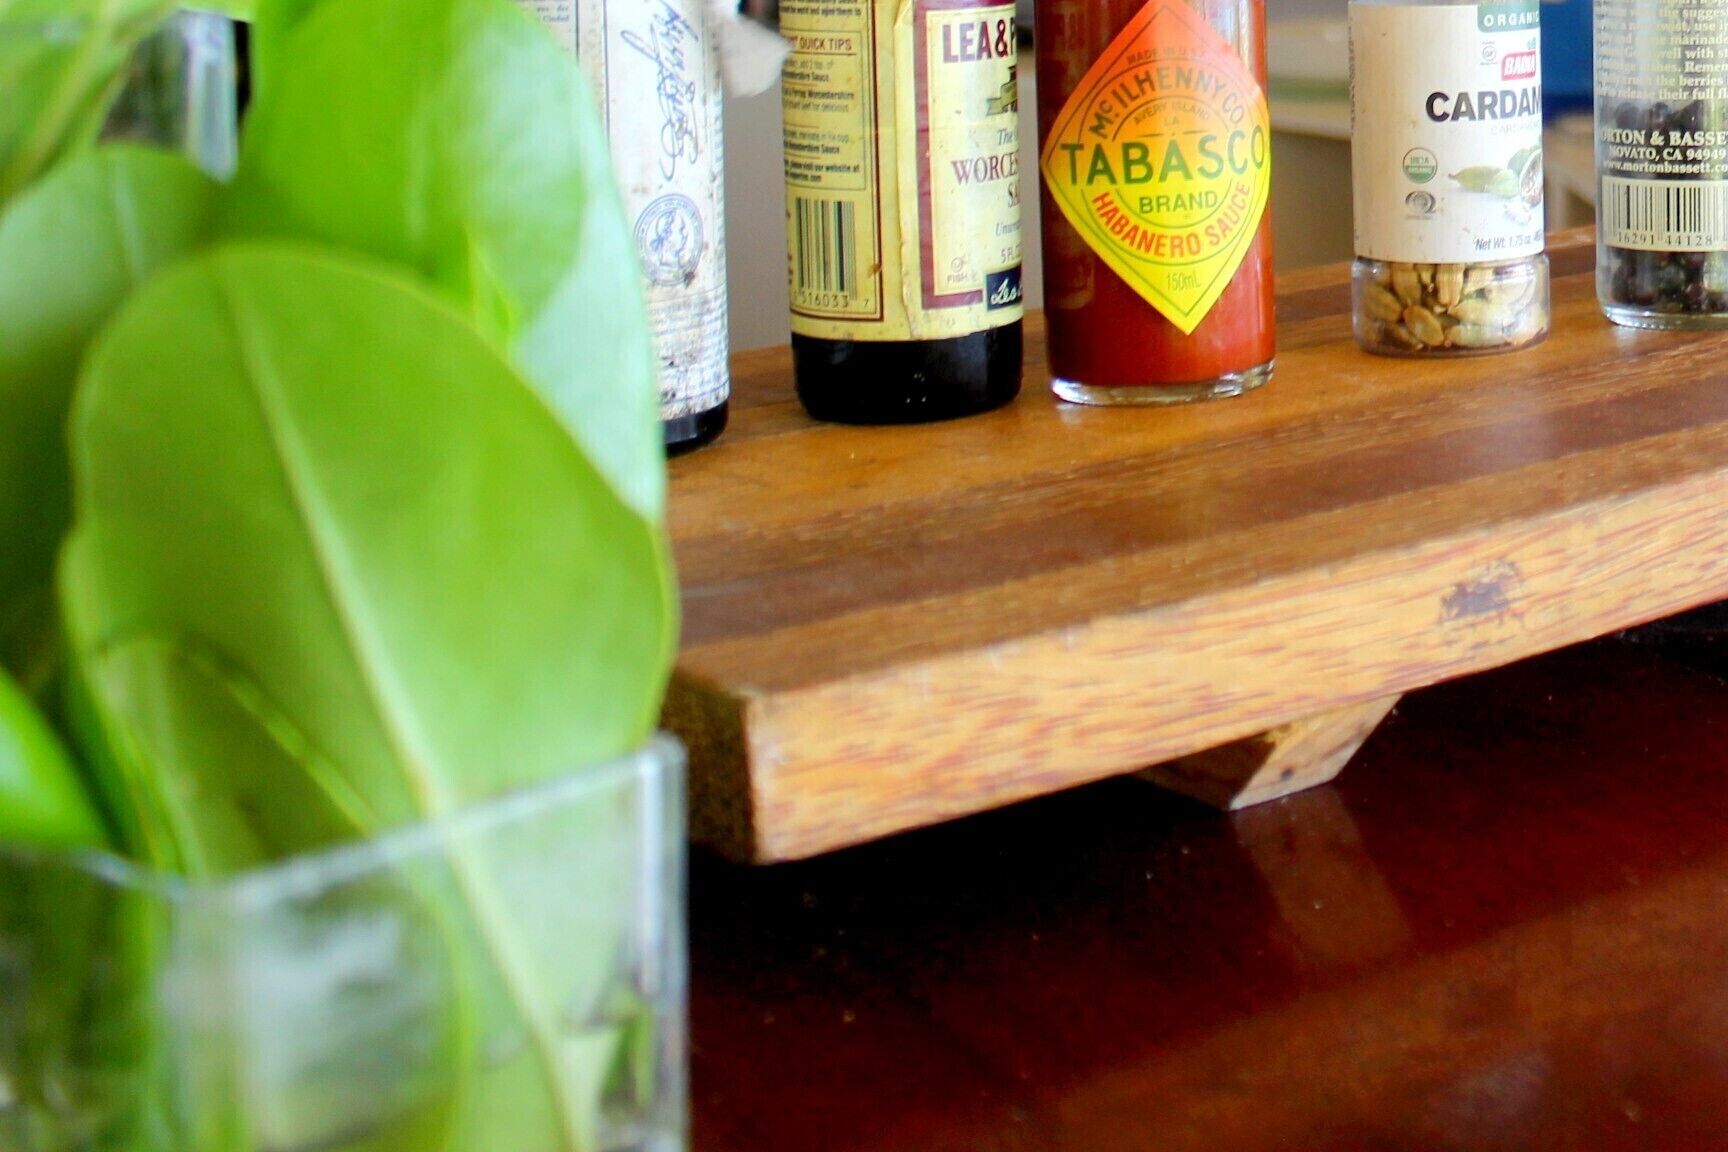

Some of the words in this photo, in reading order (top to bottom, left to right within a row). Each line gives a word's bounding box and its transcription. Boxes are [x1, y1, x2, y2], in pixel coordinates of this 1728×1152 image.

[799, 37, 825, 50] QUICK
[828, 38, 852, 52] TIPS
[1679, 74, 1724, 86] berries
[1659, 88, 1690, 100] their
[1691, 87, 1714, 99] full
[1650, 130, 1664, 146] &
[1060, 123, 1265, 186] TABASCO
[1662, 148, 1683, 161] CA
[1686, 148, 1727, 161] 94949
[1139, 189, 1218, 216] BRAND
[1092, 191, 1201, 258] HABANERO
[1208, 181, 1251, 247] SAUCE
[1665, 234, 1713, 246] 44128
